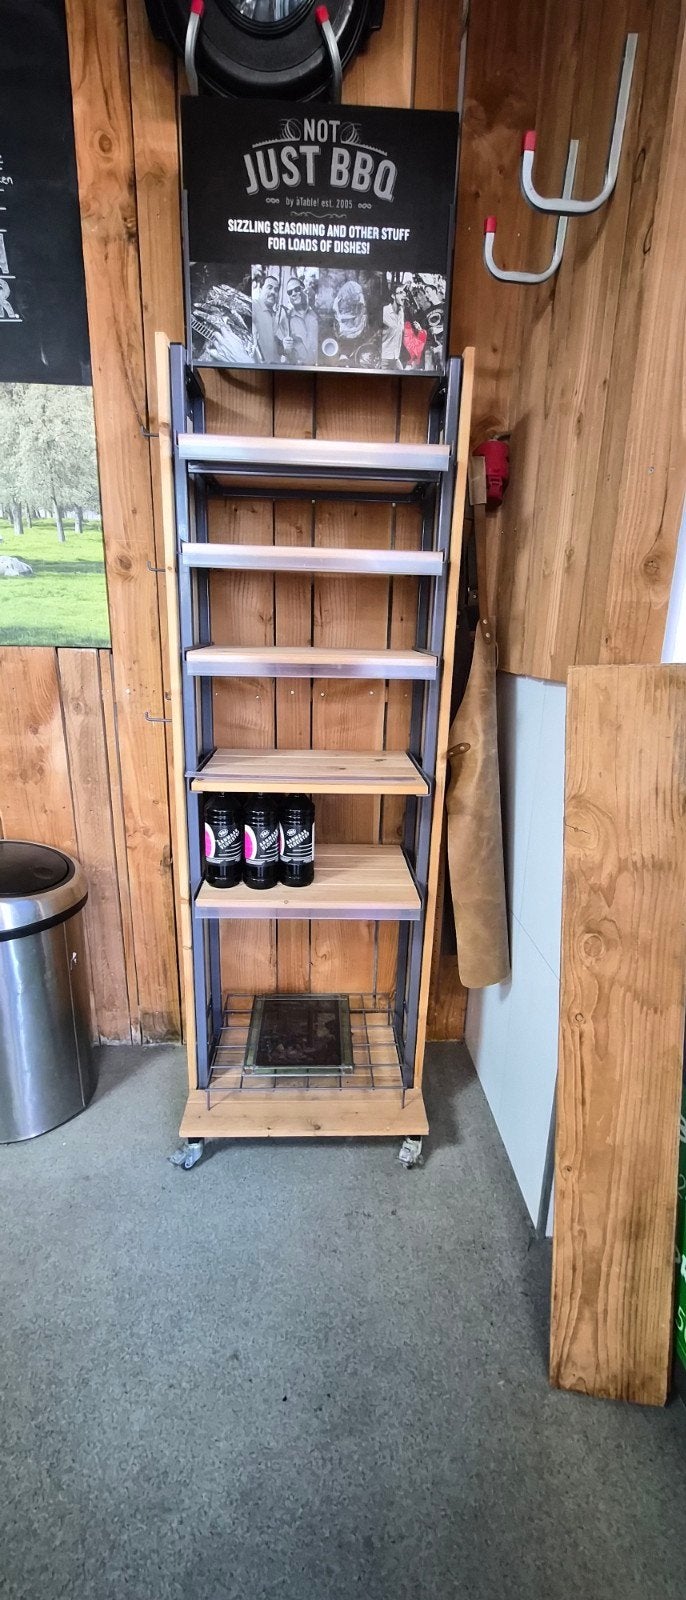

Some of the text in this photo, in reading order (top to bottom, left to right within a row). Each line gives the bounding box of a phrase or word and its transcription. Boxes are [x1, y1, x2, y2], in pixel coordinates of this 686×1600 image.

[304, 118, 340, 143] NOT
[243, 145, 398, 202] JUST BBQ
[285, 197, 294, 207] by
[336, 199, 353, 209] 2005
[228, 219, 410, 241] SIZZLING SEASONING AND OTHER STUFF
[268, 237, 370, 254] FOR LOADS OF DISHES!
